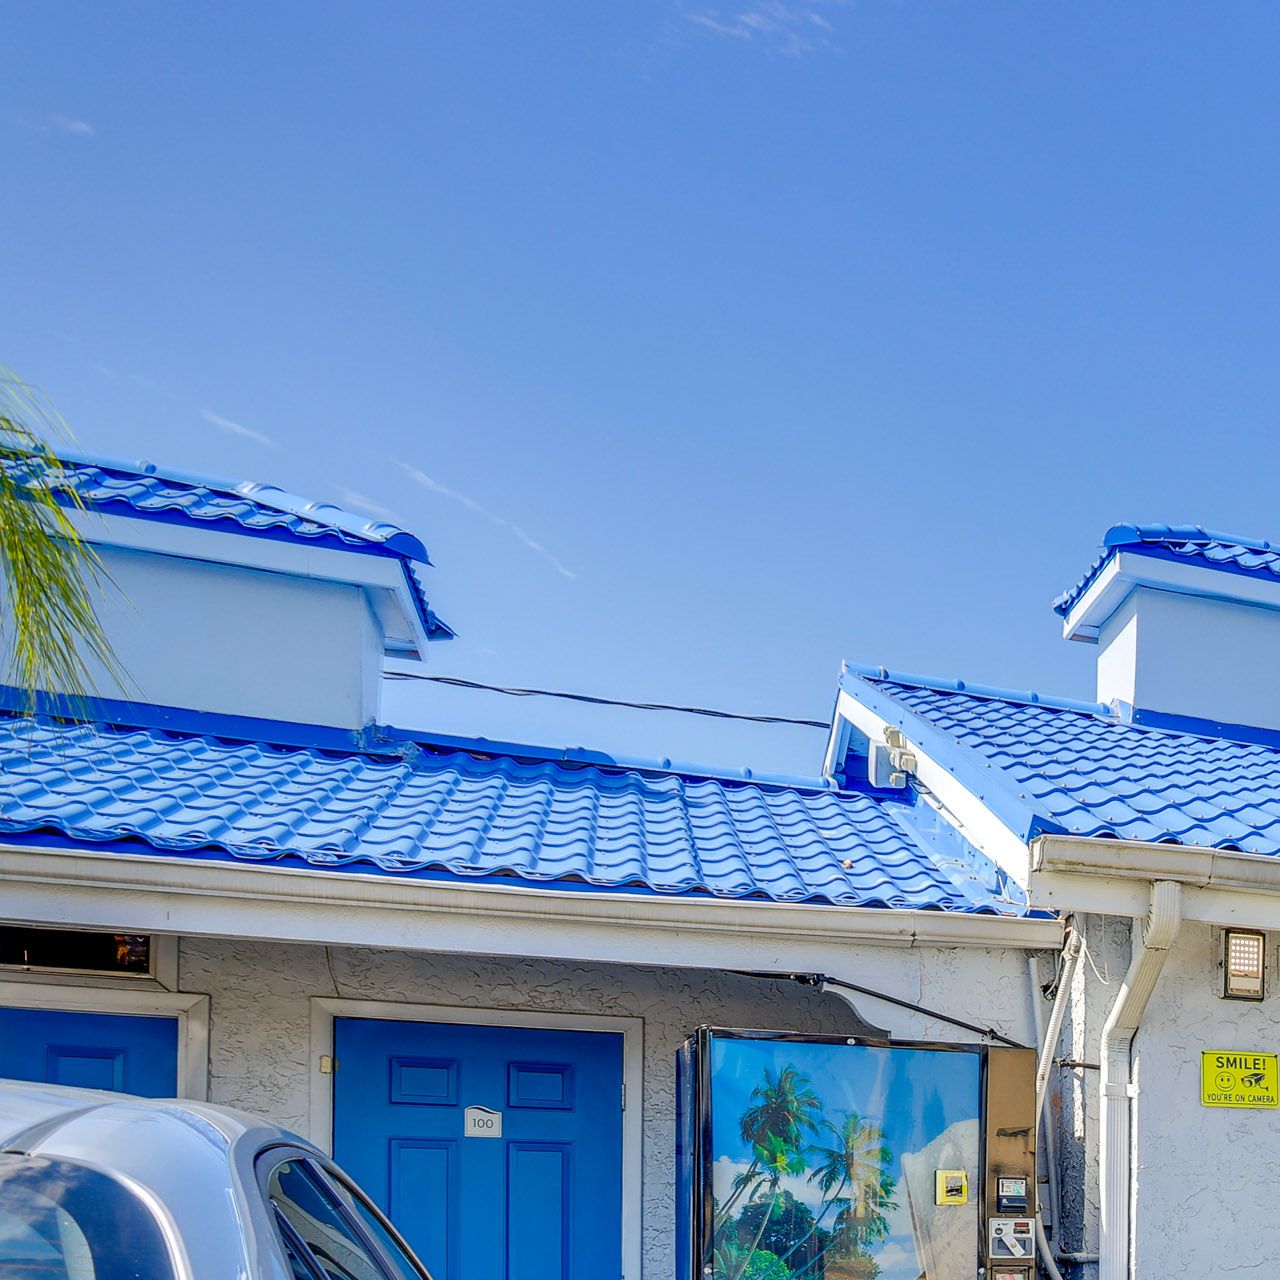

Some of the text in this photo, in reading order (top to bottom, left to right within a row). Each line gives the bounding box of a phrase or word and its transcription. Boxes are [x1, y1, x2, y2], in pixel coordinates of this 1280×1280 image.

[1216, 1056, 1266, 1070] SMILE!
[1207, 1093, 1275, 1103] YOU'RE ON CAMERA
[472, 1118, 494, 1128] 100
